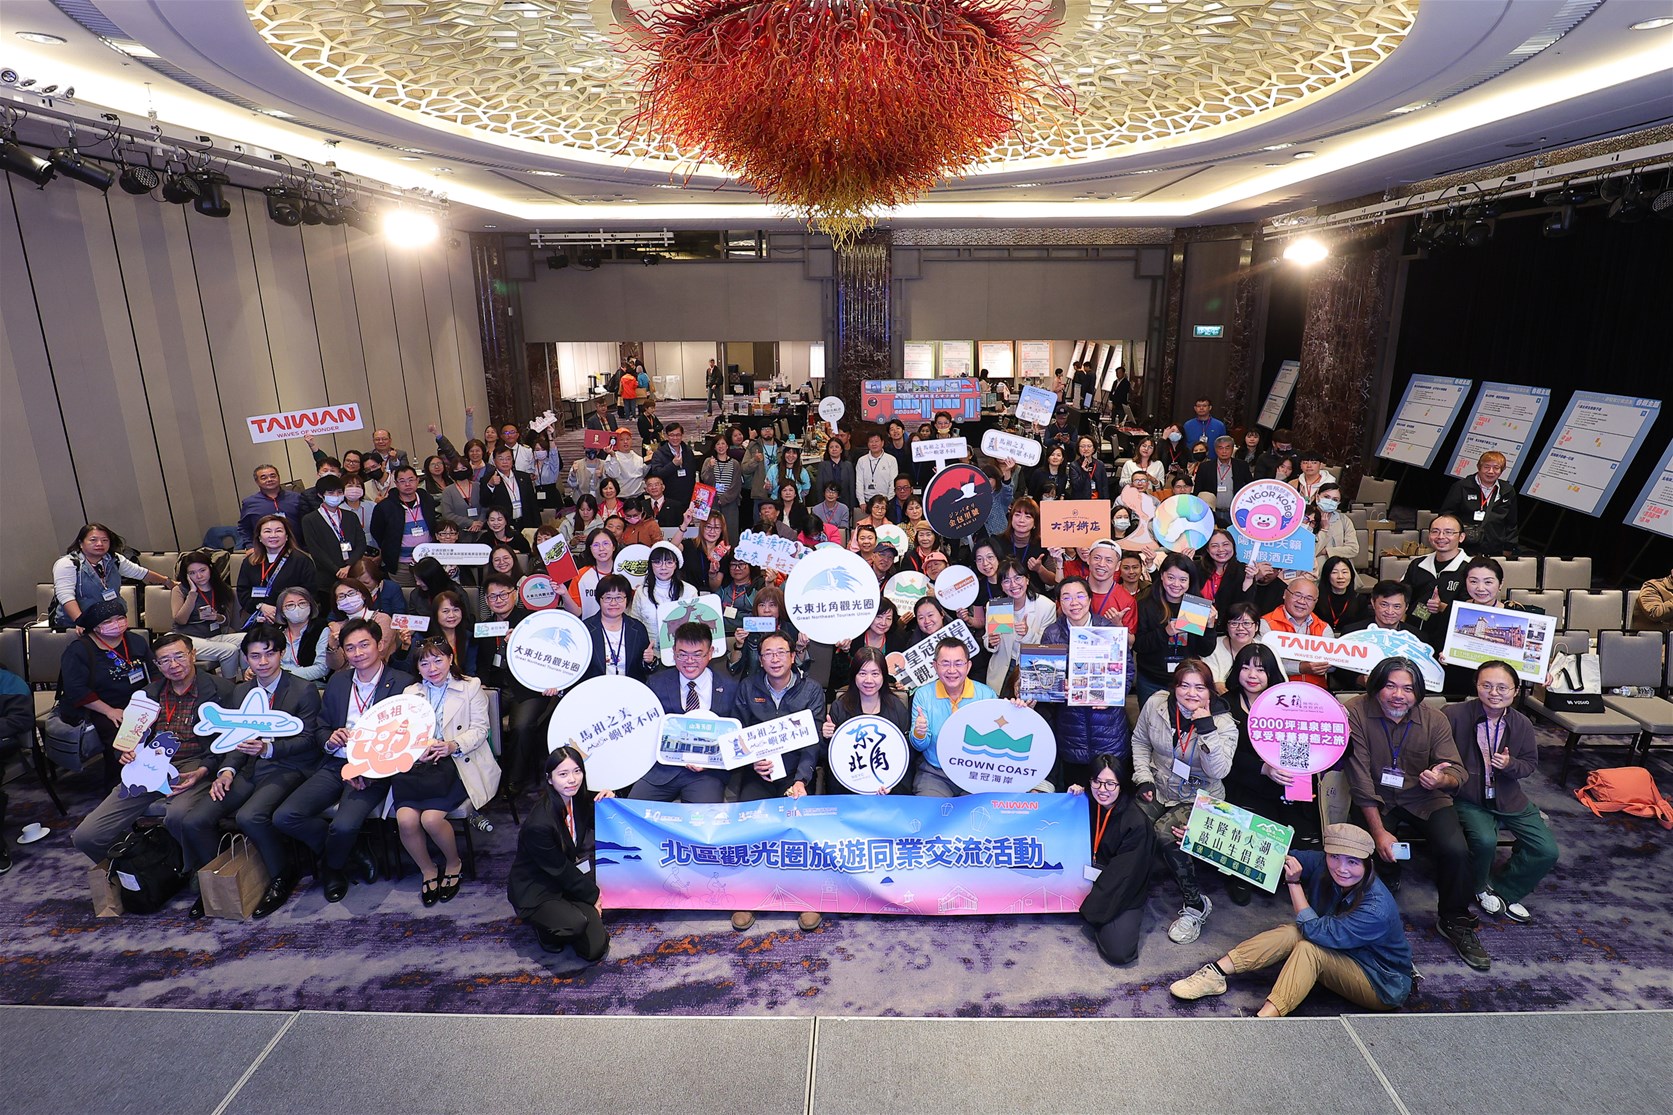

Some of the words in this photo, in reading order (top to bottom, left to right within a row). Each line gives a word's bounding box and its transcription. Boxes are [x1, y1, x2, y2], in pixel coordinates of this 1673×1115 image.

[251, 407, 356, 433] TAIWAN
[310, 426, 339, 434] WONDER
[1245, 490, 1276, 505] VIGOR
[1276, 493, 1293, 519] KOBO
[792, 599, 874, 615] 大東北角觀光圈
[1277, 635, 1368, 658] TAIWAN
[514, 645, 581, 673] 大東北角觀光圈
[527, 658, 547, 668] Northeast
[547, 664, 562, 672] Tourism
[1323, 656, 1350, 664] WONDER
[377, 705, 402, 723] 馬祖
[579, 707, 632, 743] 馬祖之美
[746, 720, 789, 742] 馬祖之美
[1250, 718, 1345, 734] 2000坪溫泉樂園
[948, 757, 995, 771] CROWN
[997, 765, 1037, 777] COAST
[969, 771, 1013, 784] 皇冠海岸
[991, 800, 1039, 810] TAIWAN
[1204, 816, 1272, 855] 基隆情人湖
[659, 835, 1045, 872] 北區觀光圈旅遊同業交流活動
